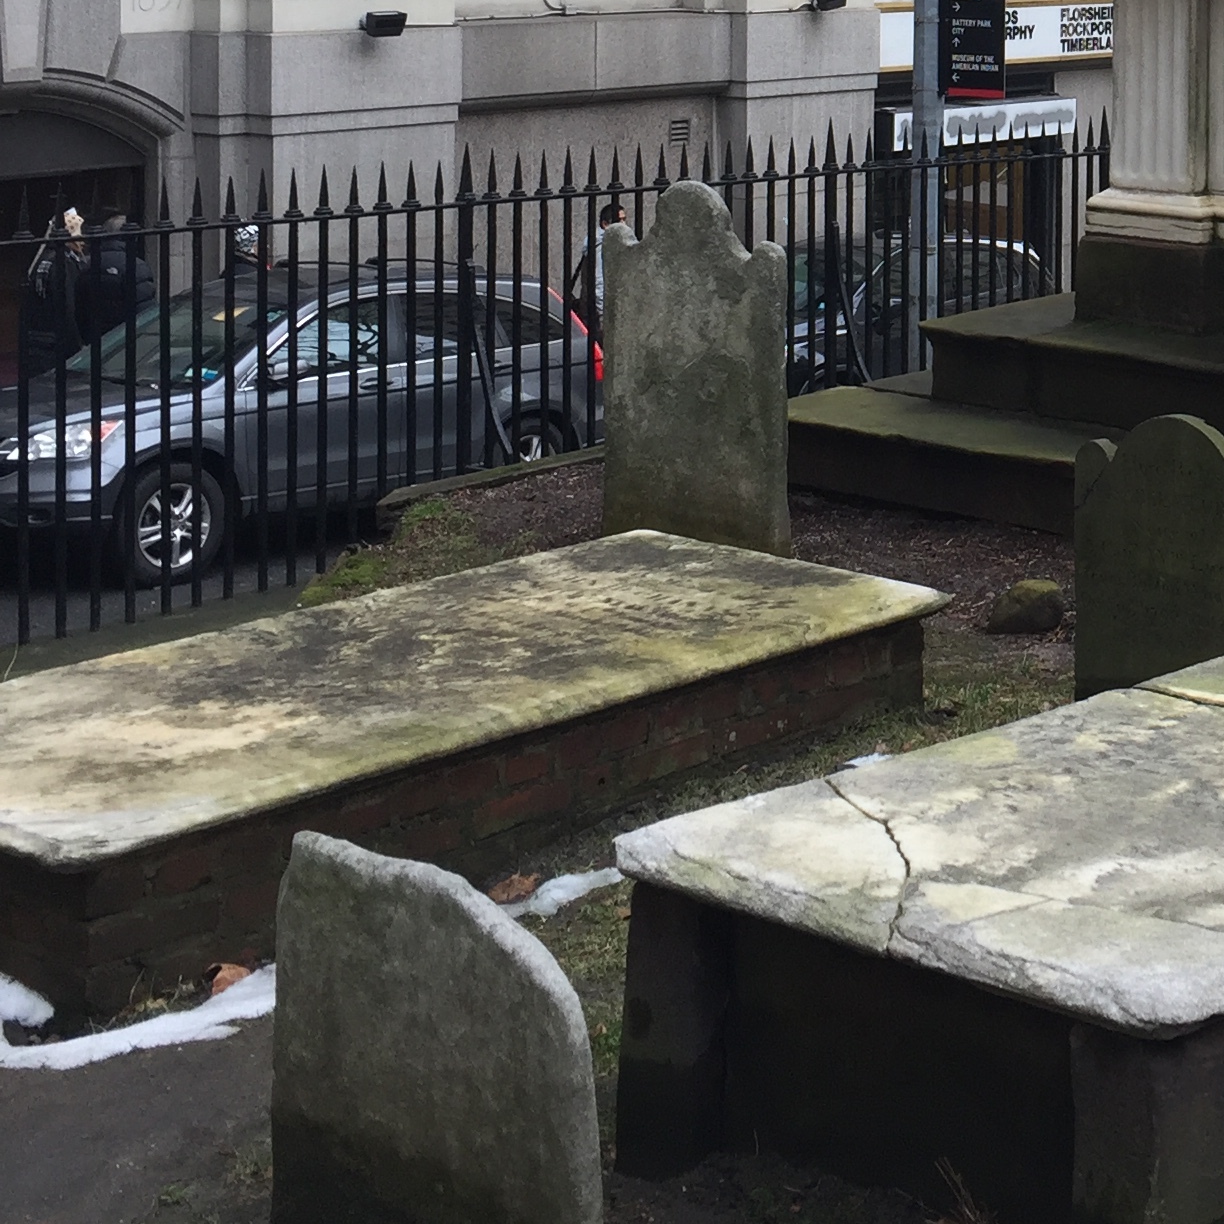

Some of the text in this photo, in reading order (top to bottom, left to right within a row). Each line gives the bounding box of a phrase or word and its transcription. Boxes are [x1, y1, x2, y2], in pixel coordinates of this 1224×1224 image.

[952, 18, 992, 28] BATTERY PARK
[952, 27, 965, 35] CITY
[1005, 21, 1112, 40] RPHY ROCKPOR
[1060, 37, 1113, 53] TIMBERLA
[952, 54, 995, 63] MUSEUM OF THE
[952, 63, 999, 72] AMERICAN INDIAN
